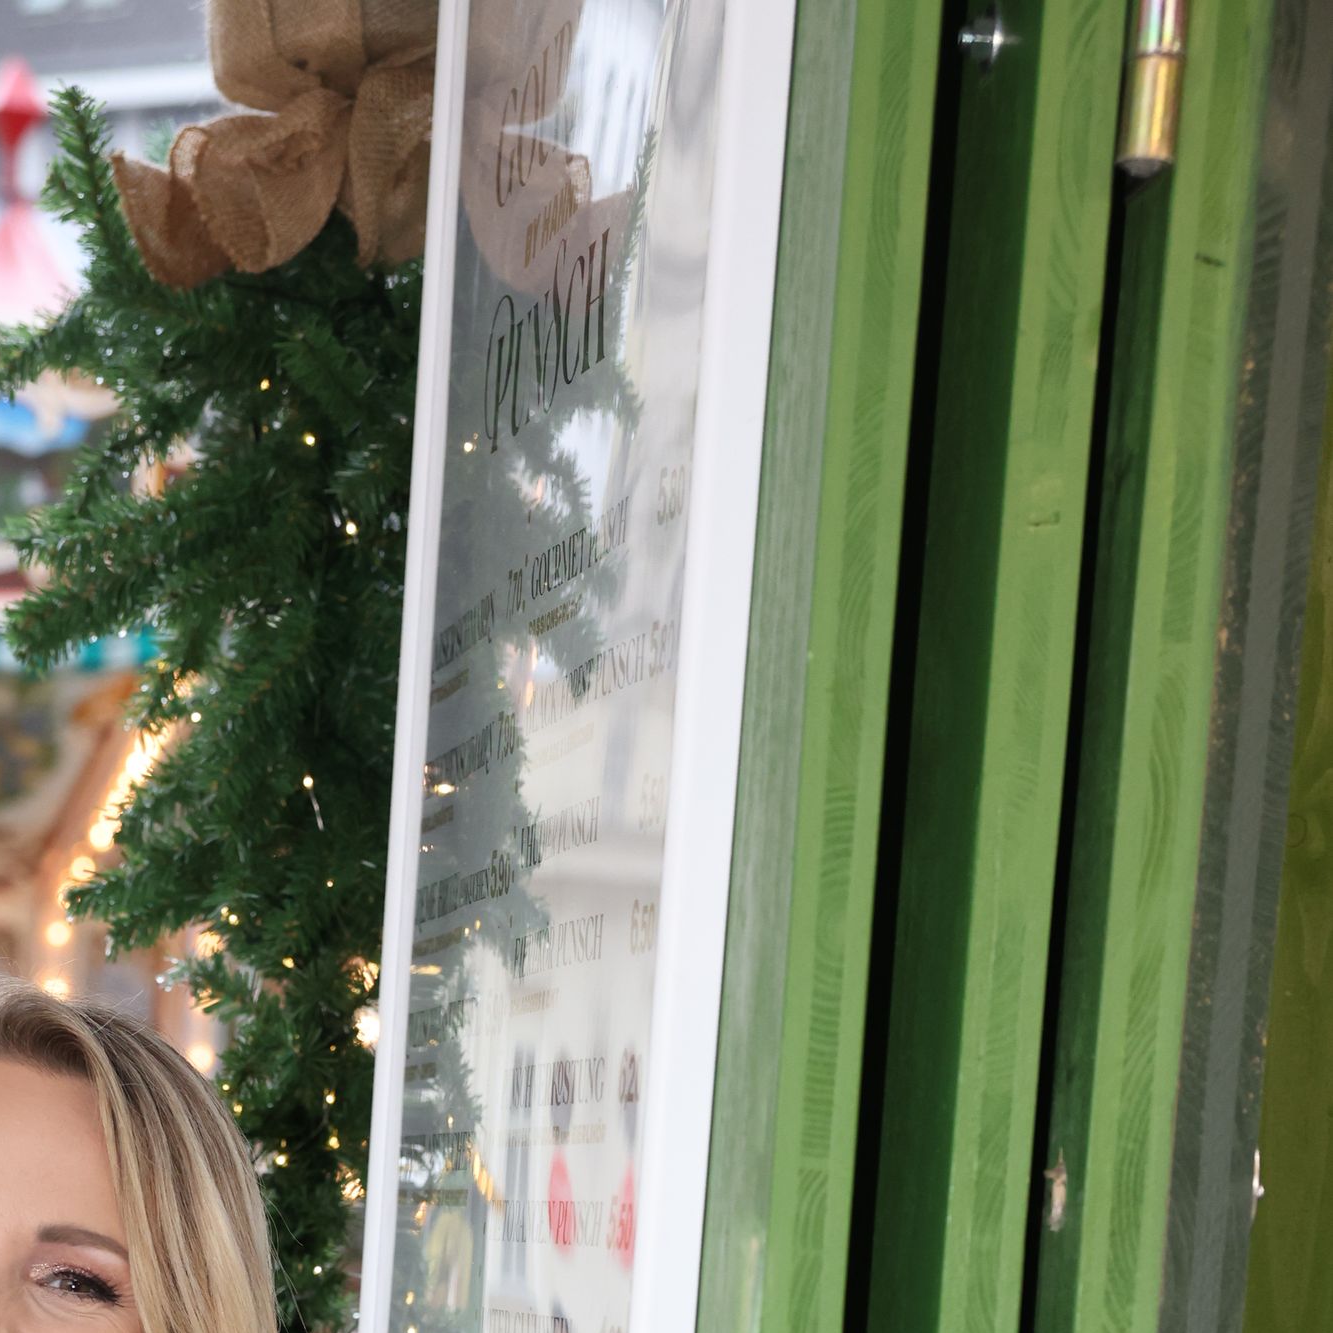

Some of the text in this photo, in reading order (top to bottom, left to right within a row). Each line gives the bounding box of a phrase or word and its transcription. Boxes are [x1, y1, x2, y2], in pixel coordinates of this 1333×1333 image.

[525, 212, 542, 269] BY
[484, 227, 611, 456] PUNSCH
[657, 465, 685, 530] 5,80
[529, 495, 632, 601] GOURMET PUNSCH
[594, 633, 647, 702] PUNSCH
[489, 849, 512, 903] 5,90
[553, 913, 604, 968] PUNSCH
[629, 898, 657, 956] 6,50
[551, 1200, 603, 1248] PUNSCH
[606, 1195, 636, 1253] 5,50
